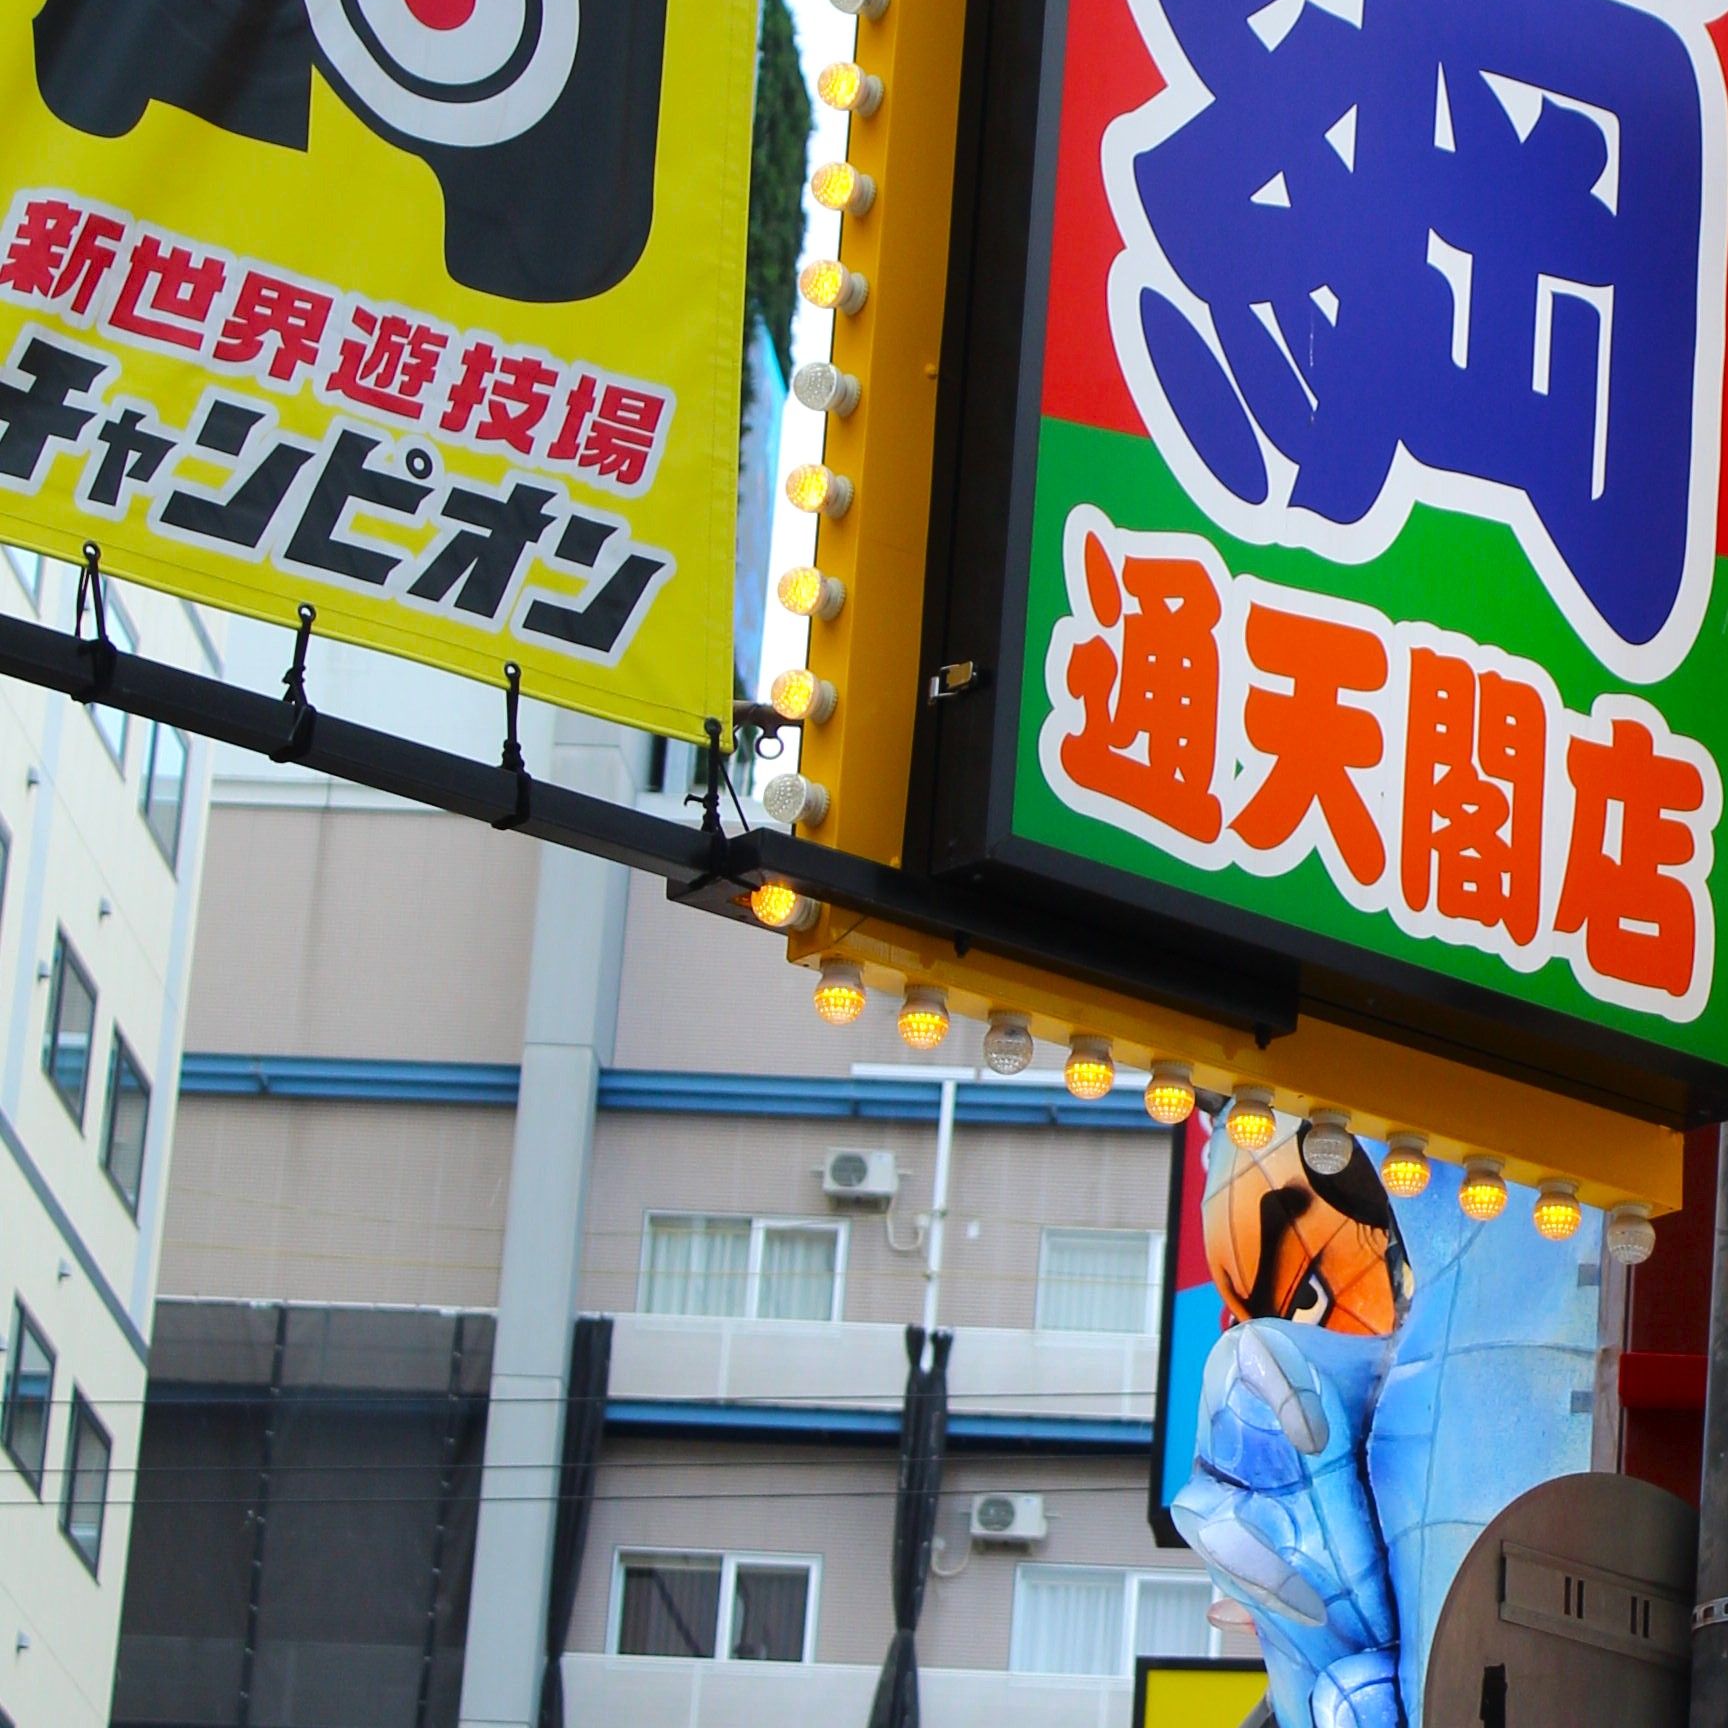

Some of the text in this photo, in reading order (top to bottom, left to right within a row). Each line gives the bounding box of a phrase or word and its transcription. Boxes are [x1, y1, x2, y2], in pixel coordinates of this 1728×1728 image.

[0, 196, 668, 488] 新世界遊技場
[0, 332, 670, 658] チャンピオン
[1052, 515, 1710, 1010] 通天閣店
